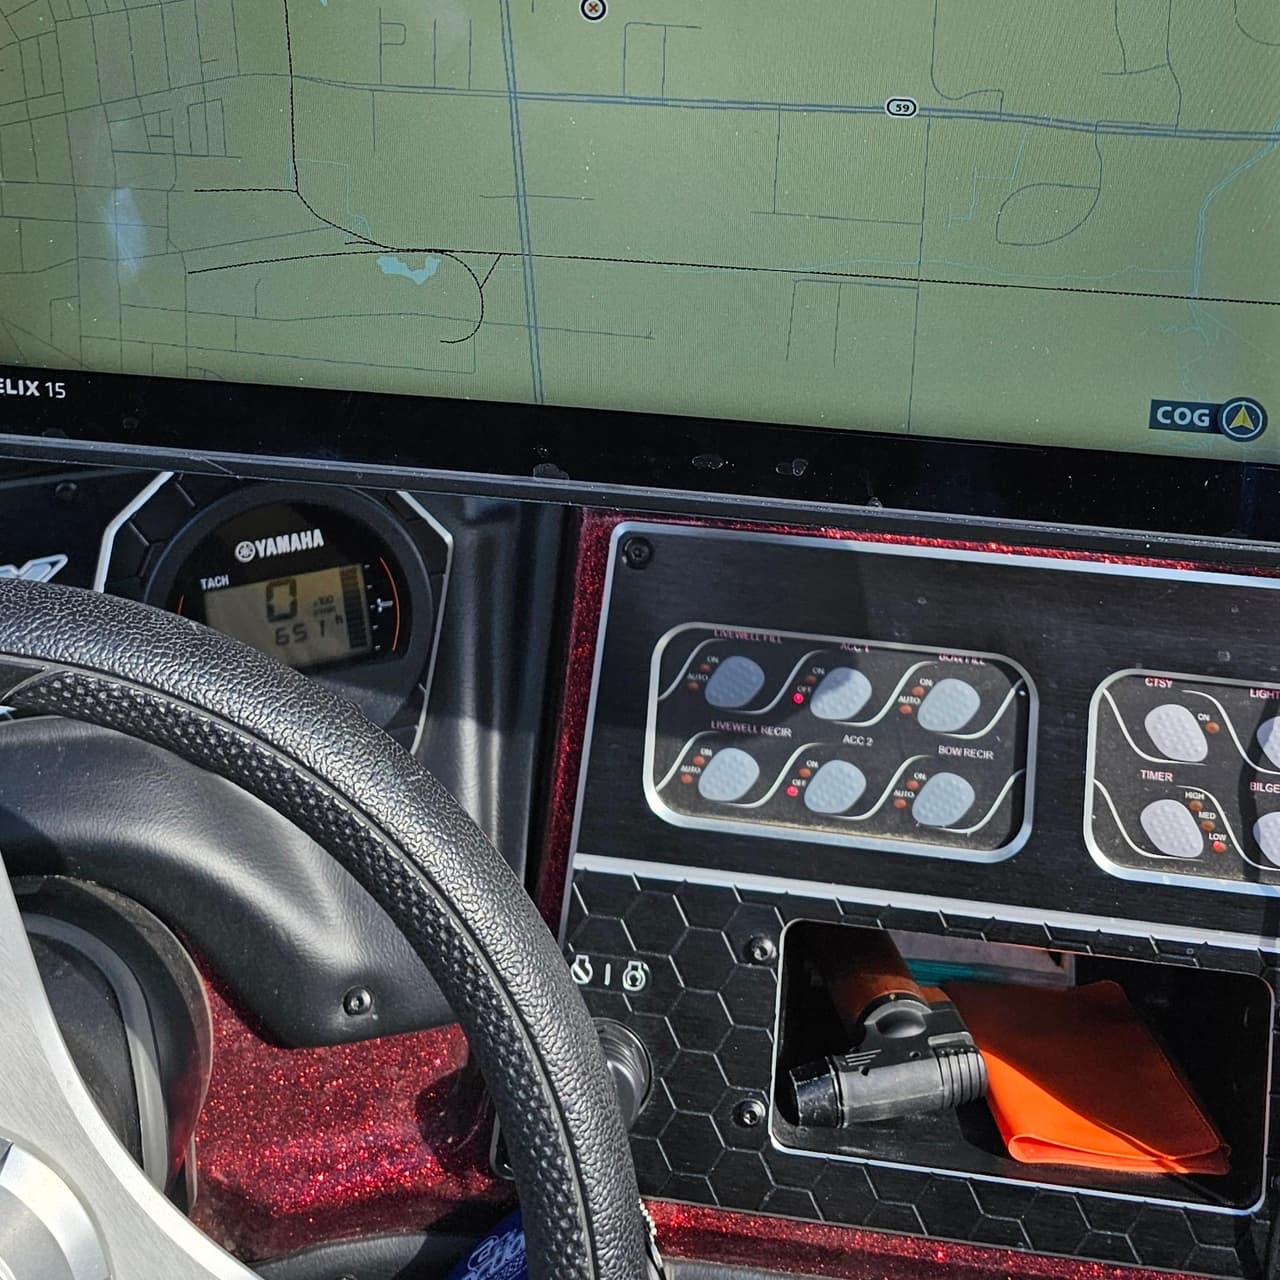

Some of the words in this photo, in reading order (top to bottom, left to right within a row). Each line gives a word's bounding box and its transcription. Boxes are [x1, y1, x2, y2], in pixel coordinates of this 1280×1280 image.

[895, 103, 910, 113] 59
[45, 381, 66, 399] 15
[1156, 406, 1210, 427] COG
[255, 528, 324, 558] YAMAHA
[200, 574, 230, 590] TACH
[706, 655, 719, 664] ON
[812, 666, 825, 675] ON
[920, 678, 933, 687] ON
[1144, 677, 1173, 689] CTSY
[898, 695, 921, 705] AUTO
[1197, 712, 1210, 721] ON
[711, 720, 759, 734] LIVEWELL
[761, 726, 793, 738] RECIR
[842, 734, 865, 746] ACC
[866, 736, 873, 747] 2
[700, 747, 713, 756] ON
[938, 744, 963, 757] BOW
[963, 747, 994, 760] RECIR
[806, 759, 818, 768] ON
[913, 772, 927, 781] ON
[1140, 769, 1174, 782] TIMER
[1249, 781, 1280, 794] BILGE
[893, 789, 915, 798] AUTO
[1184, 791, 1205, 800] HIGH
[1198, 810, 1217, 820] MED
[1208, 832, 1227, 841] LOW
